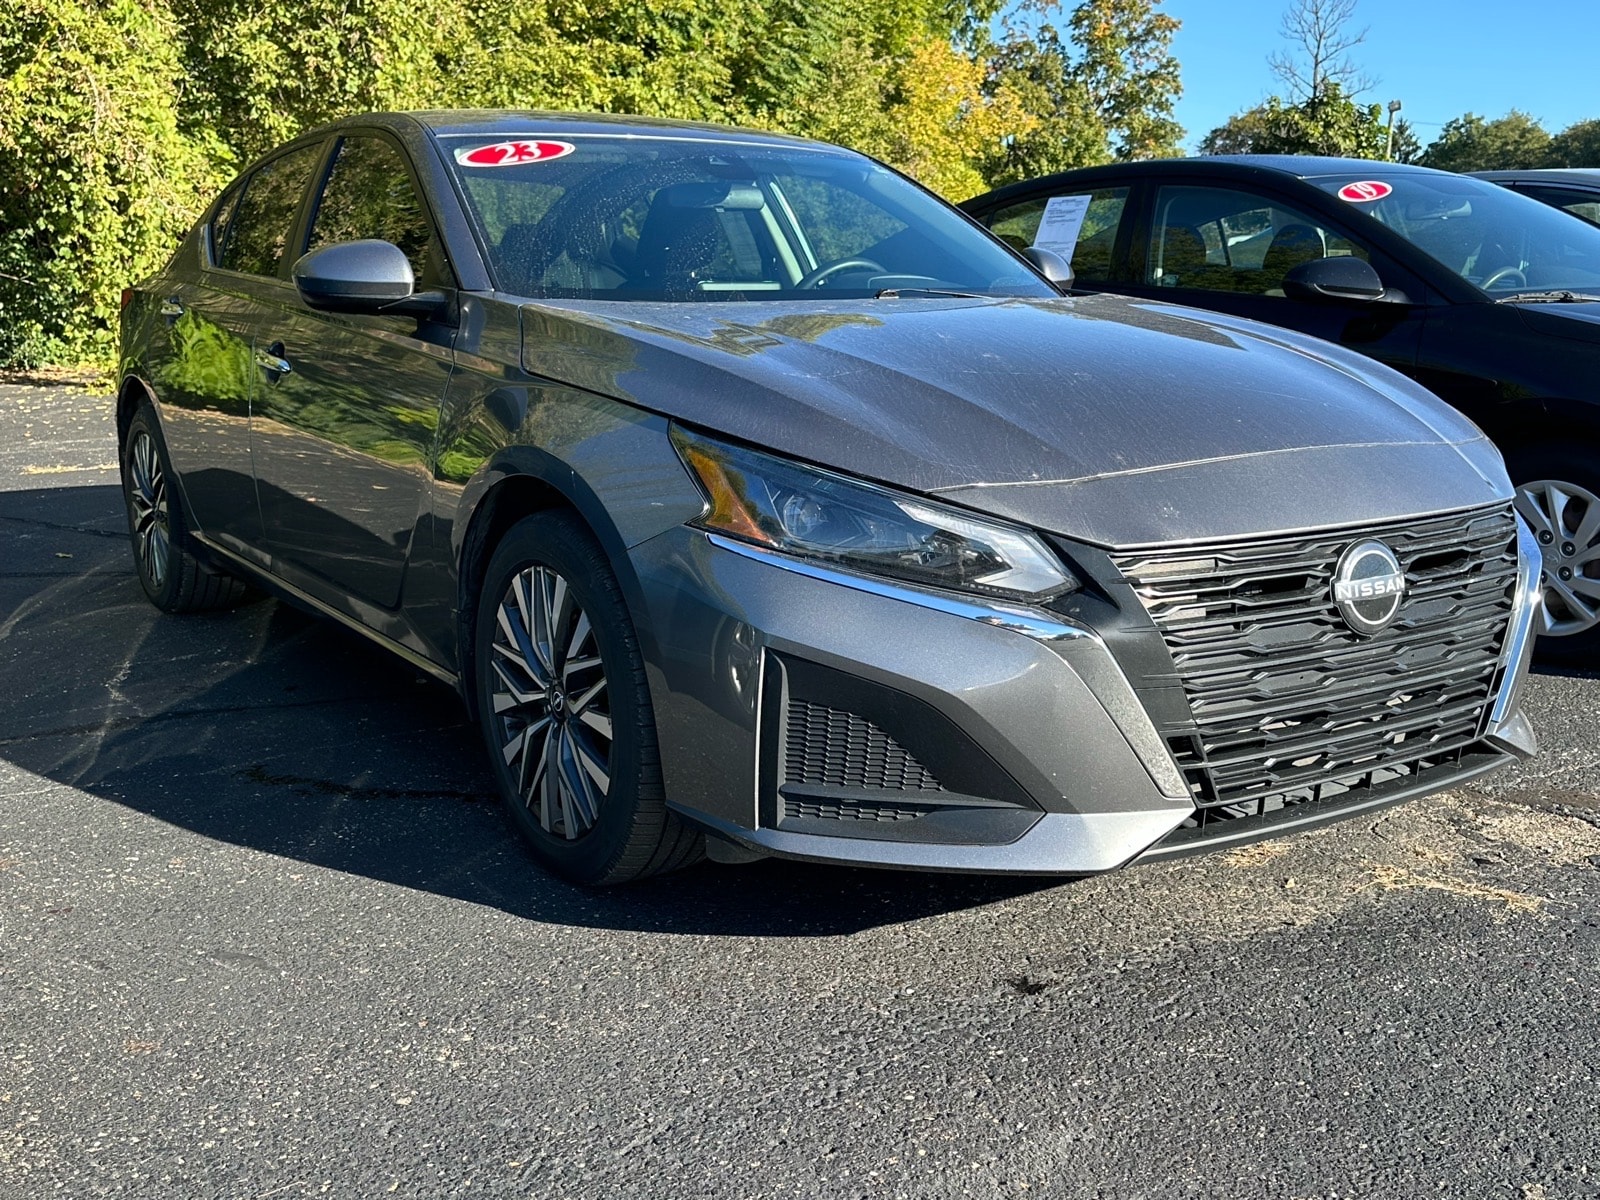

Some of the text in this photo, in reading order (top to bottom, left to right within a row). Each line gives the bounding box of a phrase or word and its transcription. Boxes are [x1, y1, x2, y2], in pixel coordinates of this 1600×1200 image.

[495, 142, 541, 164] 23
[1349, 183, 1377, 199] 19
[1336, 575, 1405, 599] NISSAN
